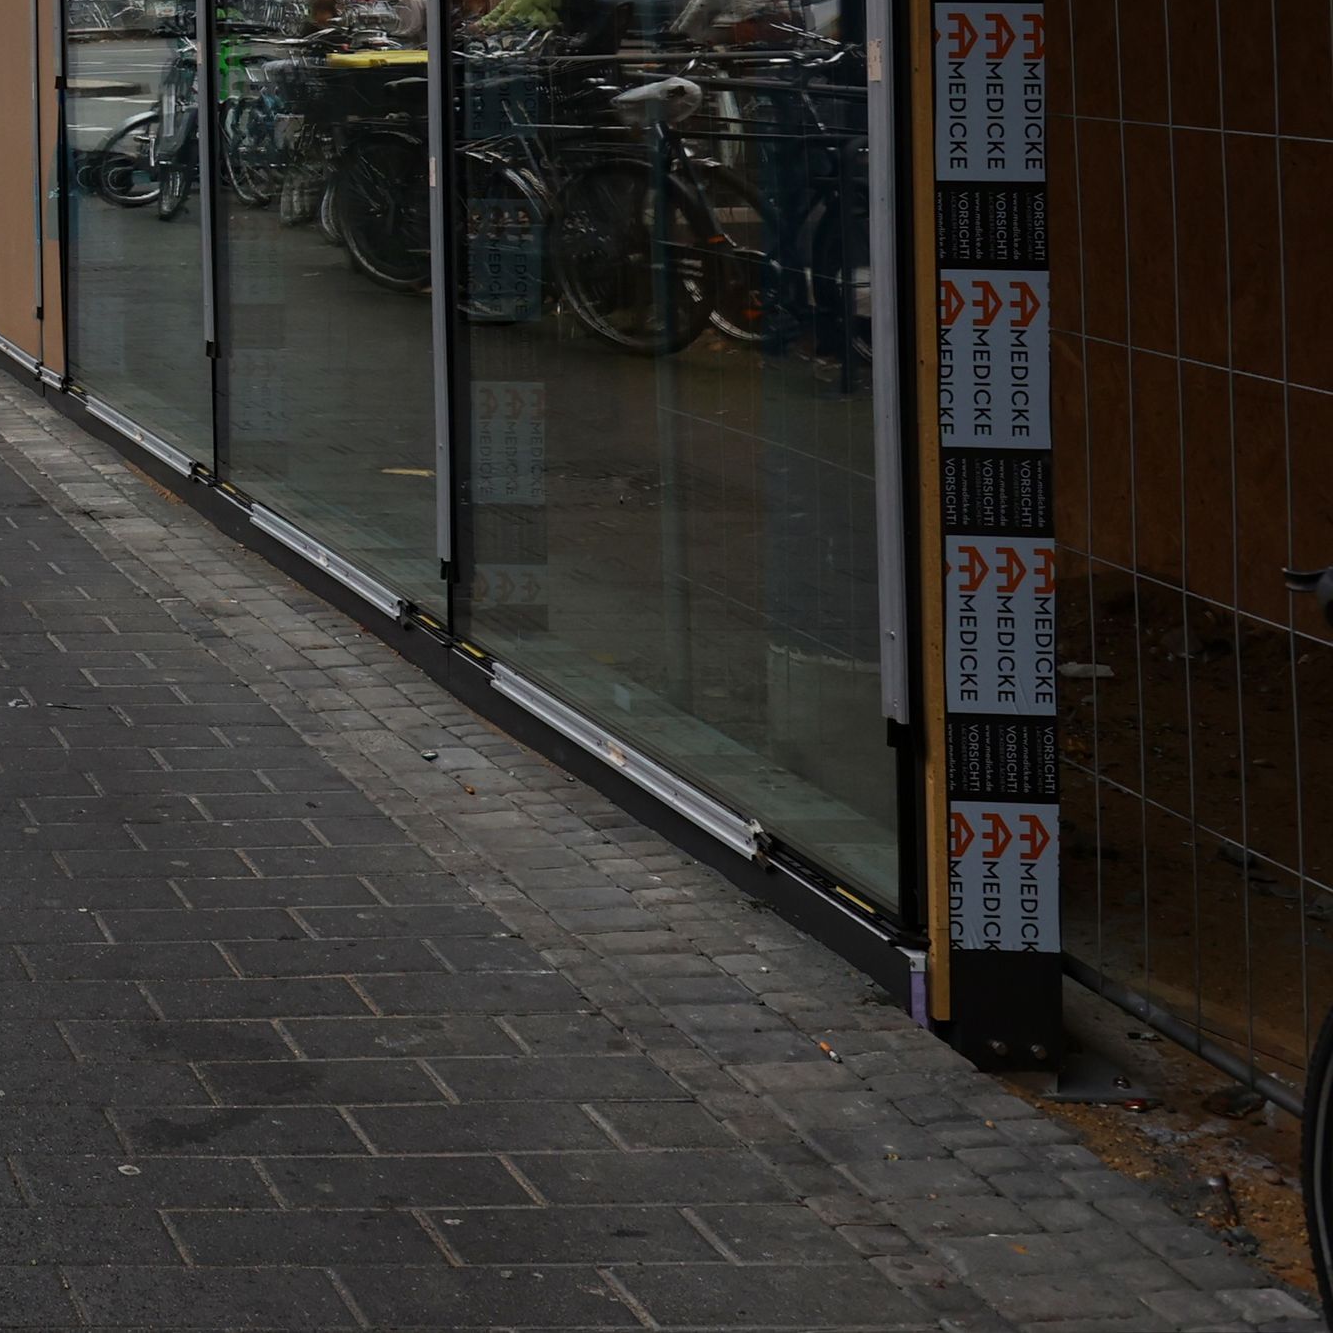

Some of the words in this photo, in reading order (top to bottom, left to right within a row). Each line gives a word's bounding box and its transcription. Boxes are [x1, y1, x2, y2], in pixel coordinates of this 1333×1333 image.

[948, 62, 967, 169] MEDICKE
[986, 62, 1005, 169] MEDICKE
[1024, 62, 1043, 170] MEDICKE
[959, 192, 970, 260] VORSICHT!
[996, 192, 1007, 261] VORSICHT!
[1034, 192, 1045, 261] VORSICHT!
[973, 328, 992, 436] MEDICKE
[1011, 329, 1030, 437] MEDICKE
[945, 457, 957, 526] VORSICHT!
[983, 458, 994, 527] VORSICHT!
[1021, 459, 1032, 528] VORSICHT!
[959, 594, 978, 701] MEDICKE
[997, 596, 1016, 703] MEDICKE
[1035, 597, 1053, 704] MEDICKE
[969, 724, 980, 792] VORSICHT!
[1007, 725, 1017, 793] VORSICHT!
[1045, 726, 1055, 794] VORSICHT!
